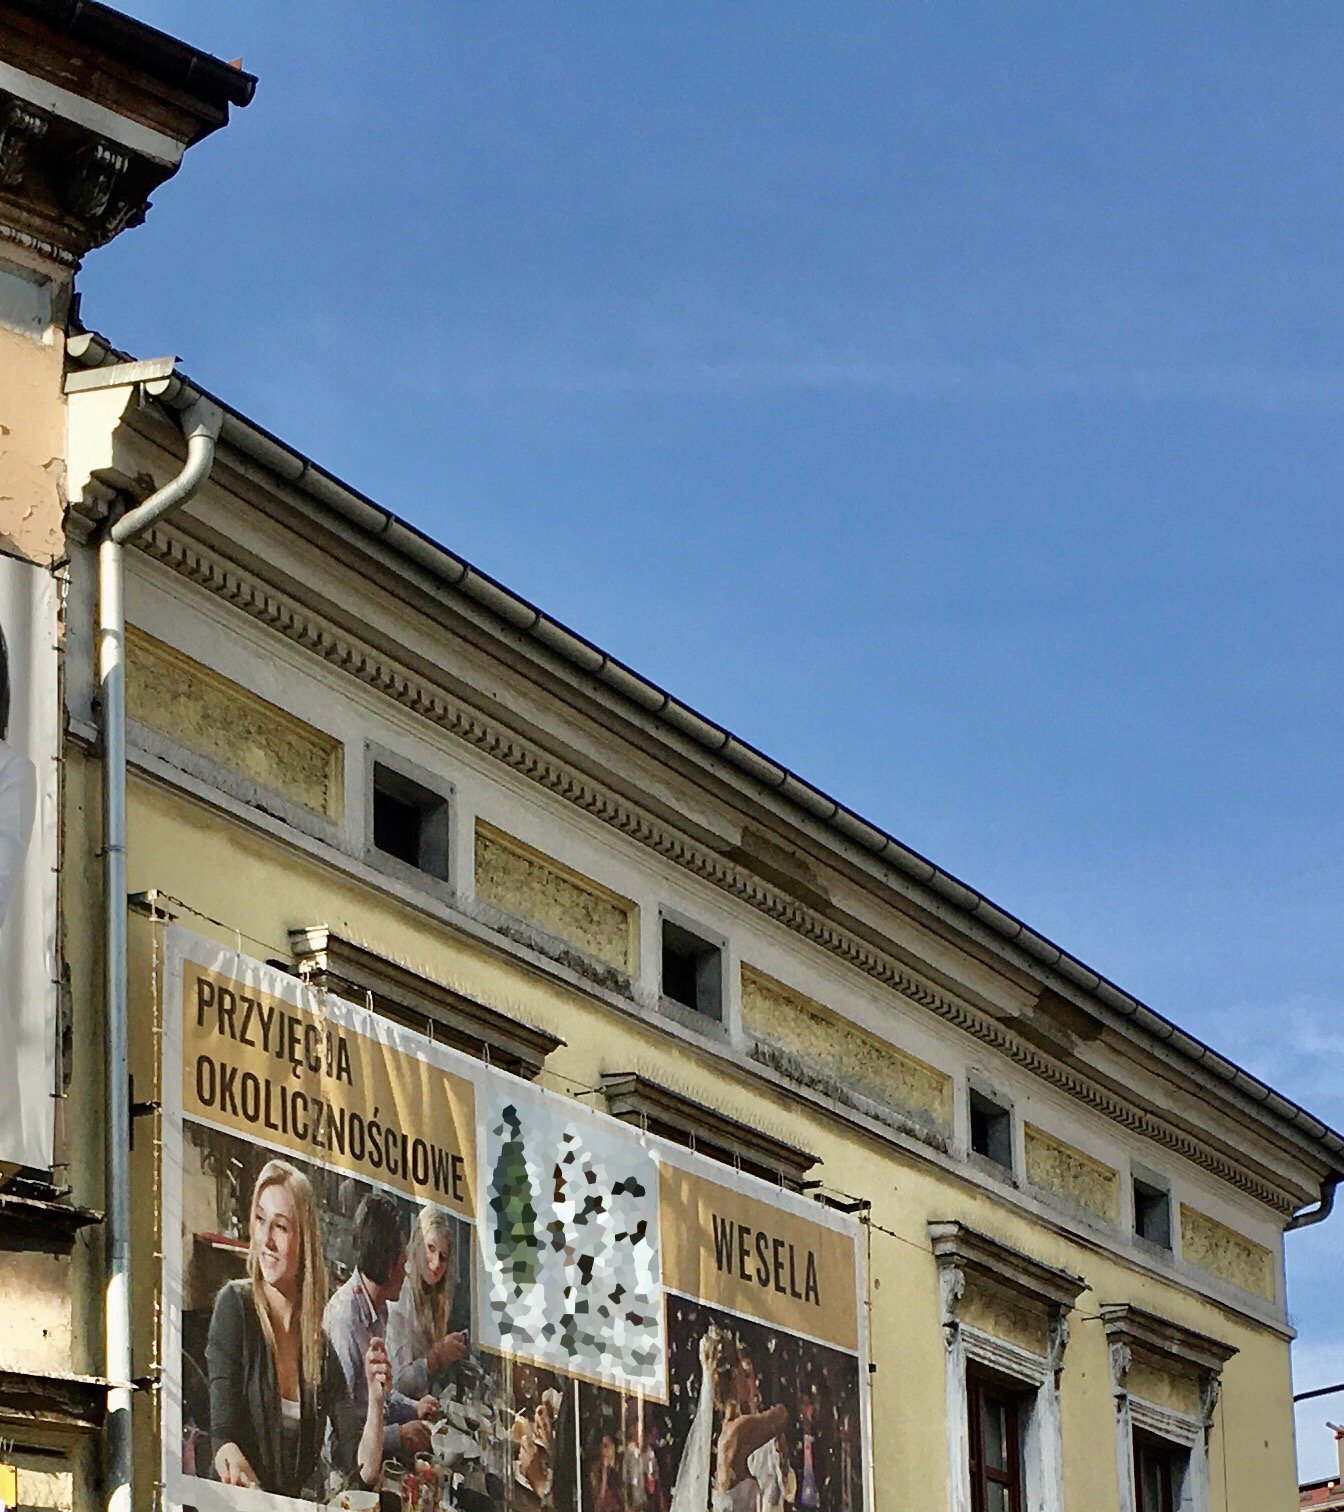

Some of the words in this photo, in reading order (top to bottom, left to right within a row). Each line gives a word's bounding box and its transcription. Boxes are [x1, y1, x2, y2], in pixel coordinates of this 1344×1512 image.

[196, 976, 353, 1086] PRZYJĘCIA
[195, 1053, 465, 1204] OKOLICZNOŚCIOWE
[712, 1212, 821, 1307] WESELA
